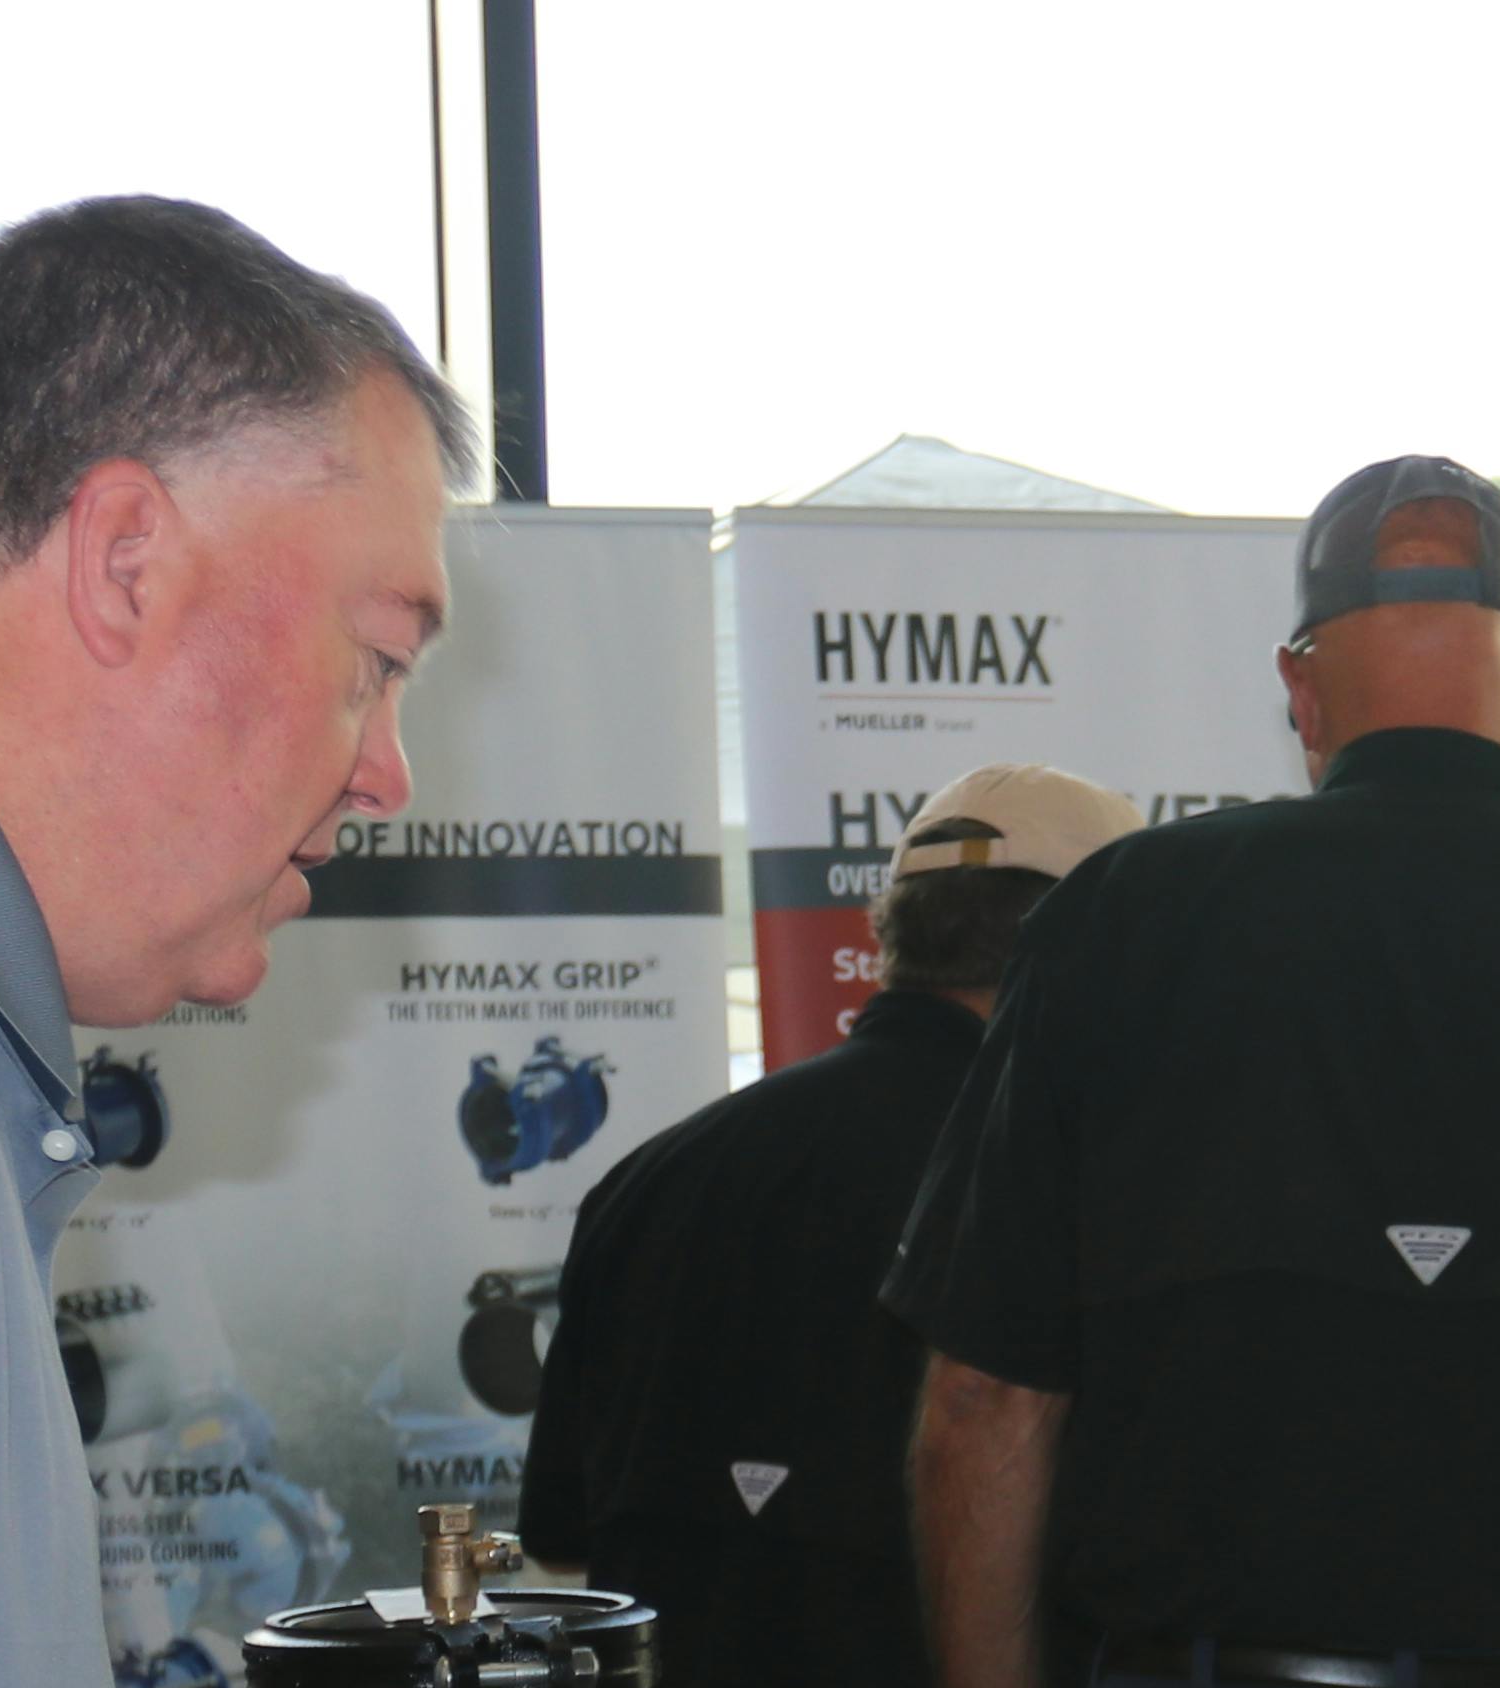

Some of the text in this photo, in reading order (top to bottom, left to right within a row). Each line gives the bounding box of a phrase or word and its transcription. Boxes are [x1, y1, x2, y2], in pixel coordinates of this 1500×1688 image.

[814, 611, 1052, 685] HYMAX
[835, 713, 925, 731] MUELLER
[335, 819, 684, 857] OF INNOVATION
[400, 961, 541, 992] HYMAX
[154, 1003, 247, 1025] LUTIONS
[387, 999, 676, 1021] THE TEETH MAKE THE DIFFERENCE
[123, 1464, 249, 1498] VERSA
[151, 1540, 240, 1566] COUPLING
